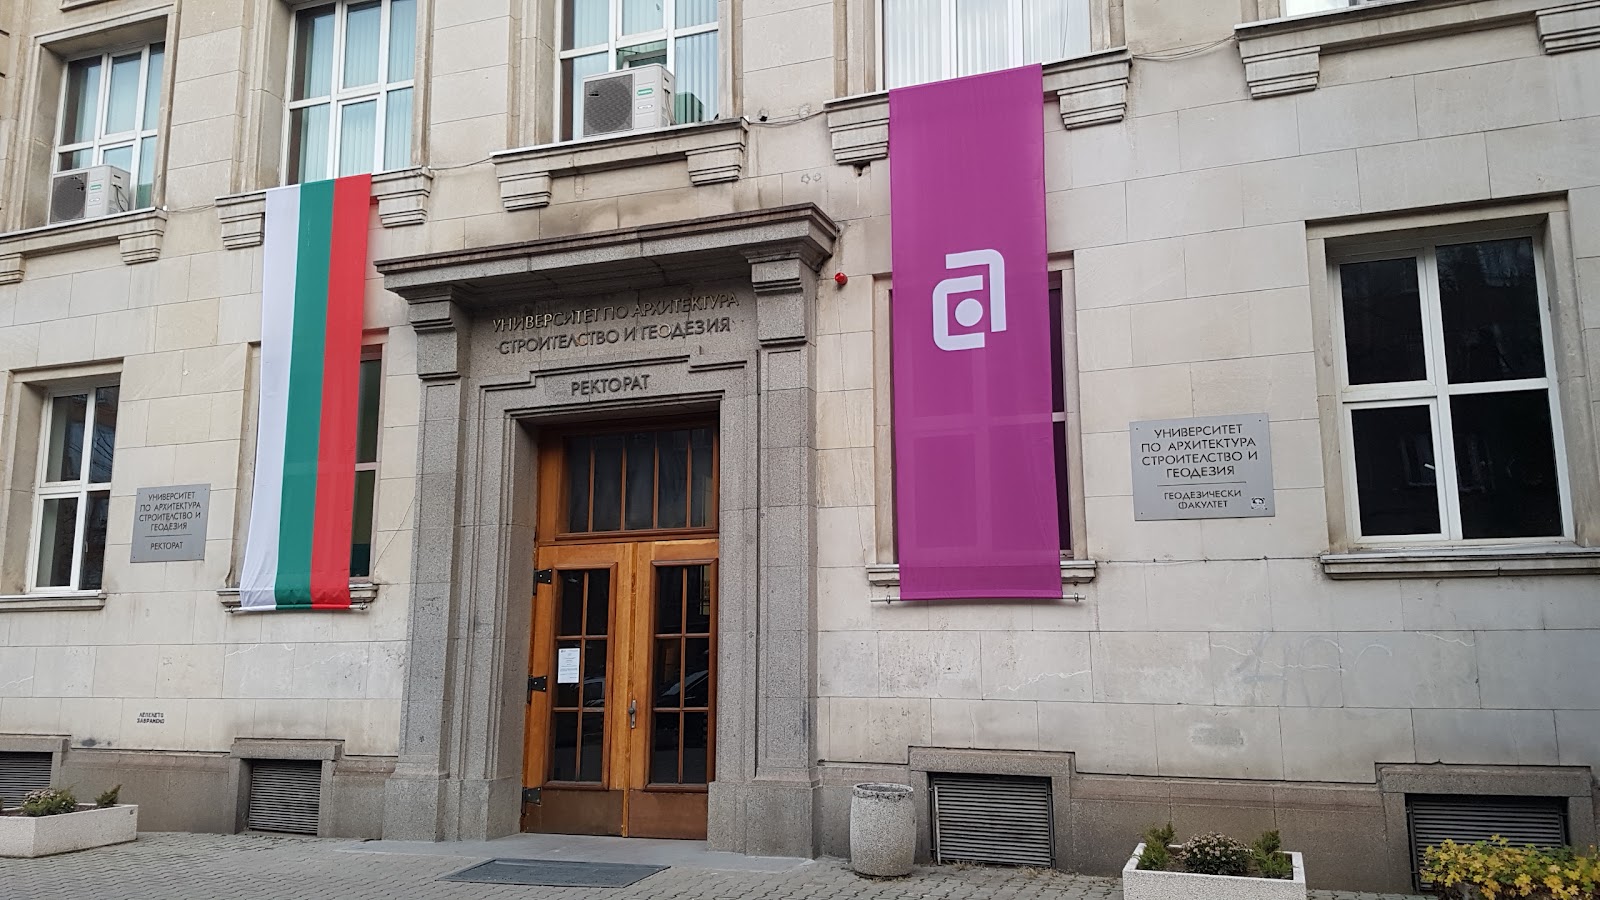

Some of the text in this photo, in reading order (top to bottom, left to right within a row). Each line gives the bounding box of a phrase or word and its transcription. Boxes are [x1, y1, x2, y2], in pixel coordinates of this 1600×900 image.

[493, 292, 739, 332] УНИВЕРСИТЕТ ПО АРХИТЕКТУРА
[499, 317, 730, 355] СТРОИТЕЛСТВО И ГЕОДЕЗИЯ
[571, 374, 650, 396] РЕКТОРАТ
[1154, 424, 1242, 438] УНИВЕРСИТЕТ
[1141, 437, 1256, 453] ПО АРХИТЕКТУРА
[1141, 450, 1258, 466] СТРОИТЕЛСТВО И
[1166, 465, 1235, 479] ГЕОДЕЗИЯ
[148, 491, 196, 501] УНИВЕРСИТЕТ
[1164, 489, 1242, 500] ГЕОДЕЗИЧЕСКИ
[140, 501, 201, 512] ПО АРХИТЕКТУРА
[1178, 500, 1228, 509] ФАКУЛТЕТ
[139, 511, 201, 522] СТРОИТЕЛСТВО И
[150, 522, 188, 532] ГЕОДЕЗИЯ
[150, 541, 184, 551] РЕКТОРАТ
